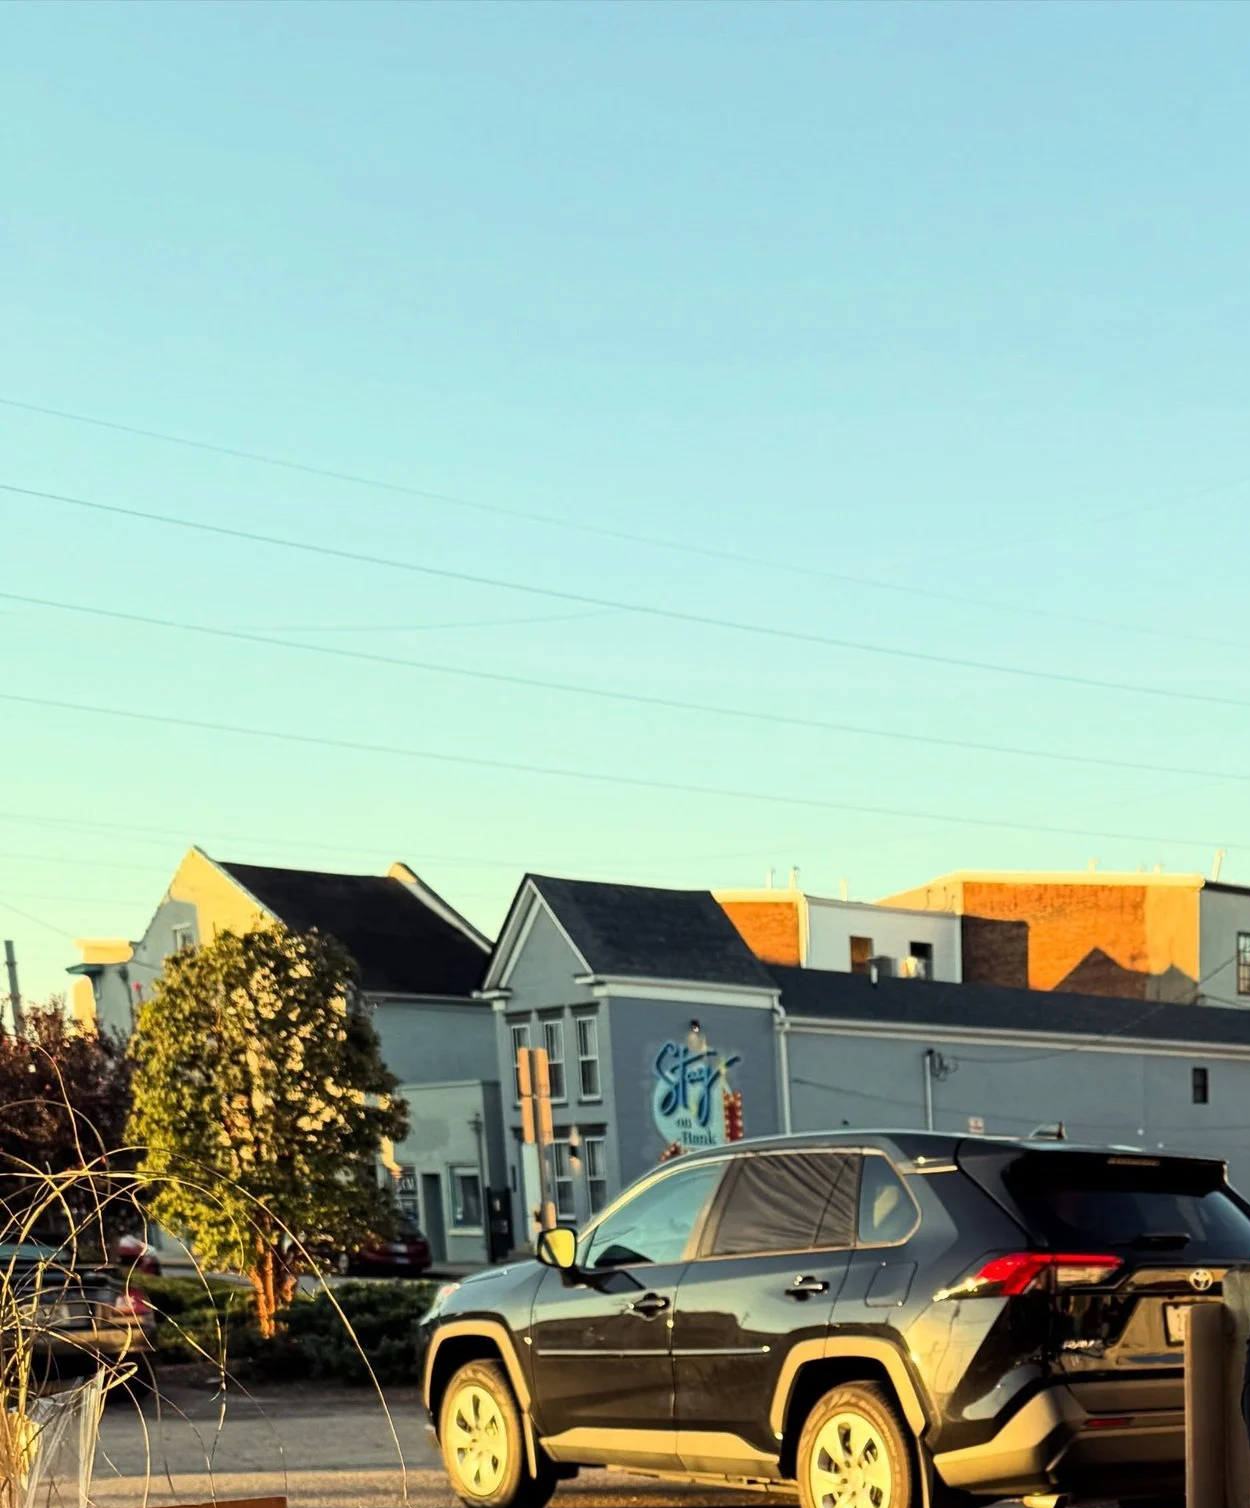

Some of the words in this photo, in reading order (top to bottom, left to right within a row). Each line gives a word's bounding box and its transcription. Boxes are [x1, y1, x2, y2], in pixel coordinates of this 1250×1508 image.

[656, 1043, 741, 1127] Stay
[675, 1119, 692, 1129] on
[682, 1128, 717, 1145] Bank
